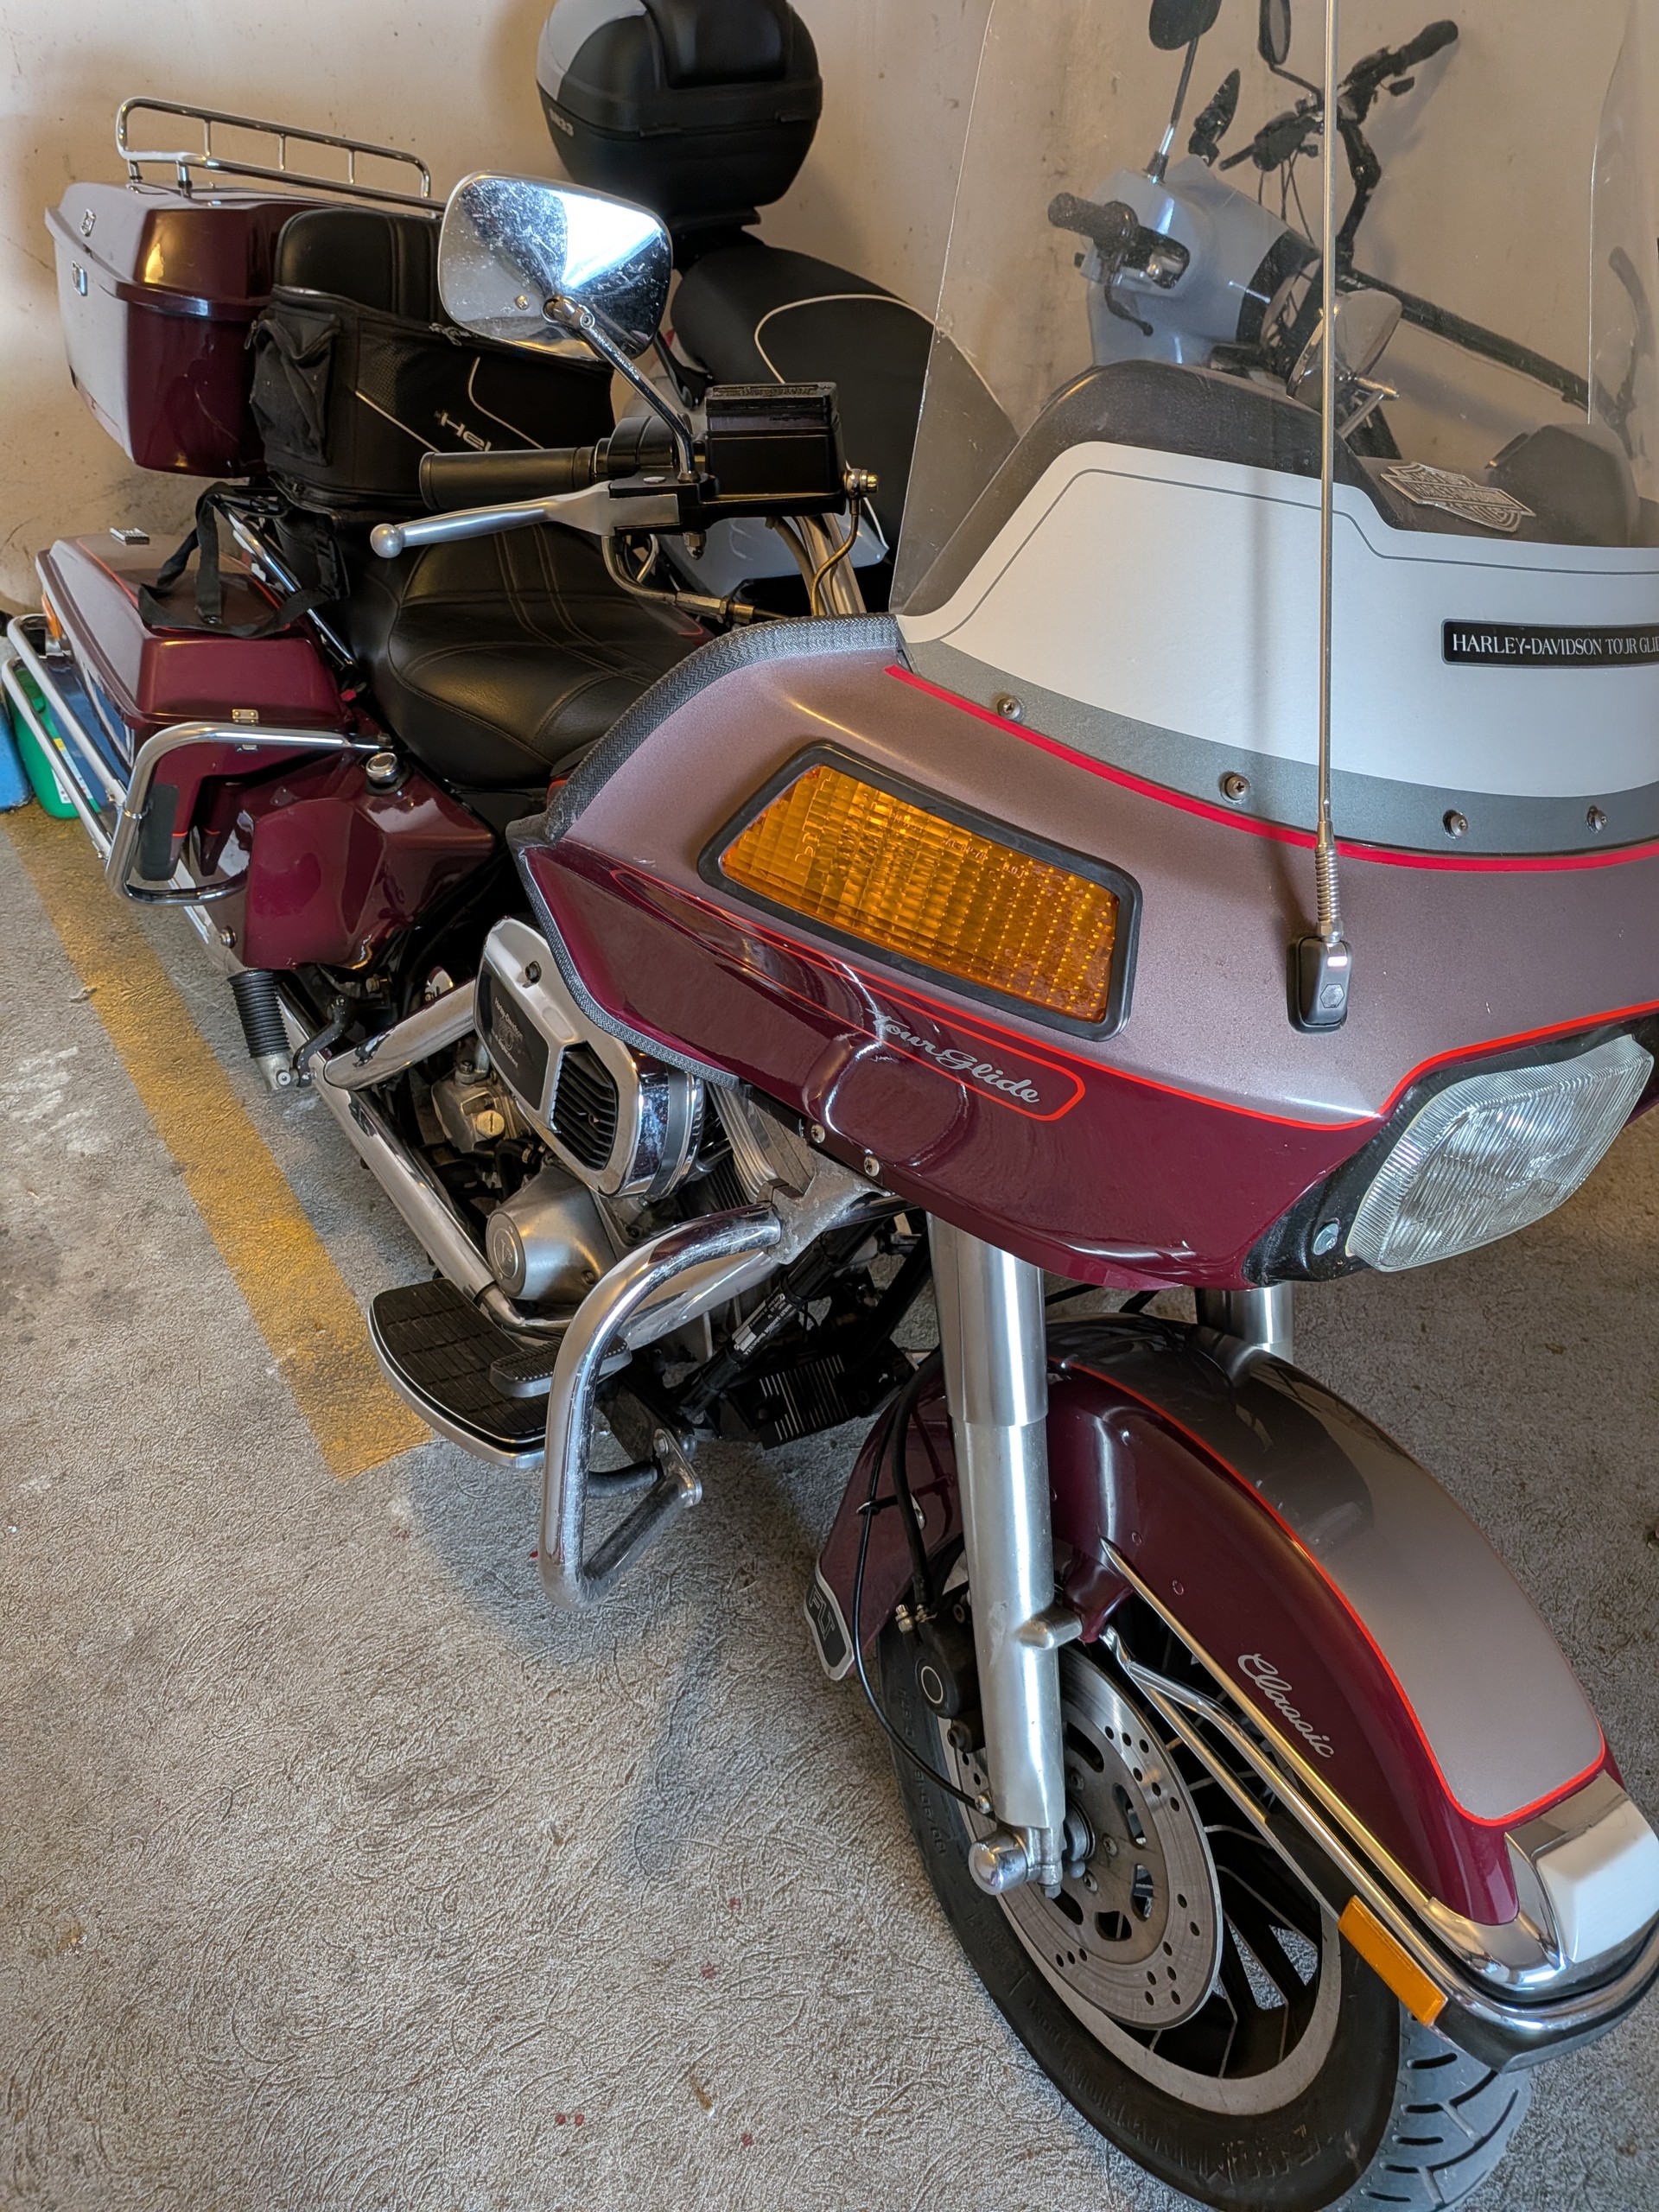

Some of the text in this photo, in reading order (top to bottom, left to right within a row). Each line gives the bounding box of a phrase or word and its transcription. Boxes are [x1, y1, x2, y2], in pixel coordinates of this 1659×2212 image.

[1452, 633, 1601, 655] HARLEY-DAVIDSON
[1605, 638, 1637, 654] TOUR
[936, 1048, 1039, 1103] Glide
[808, 1584, 836, 1641] FLT
[1237, 1653, 1335, 1758] Classic
